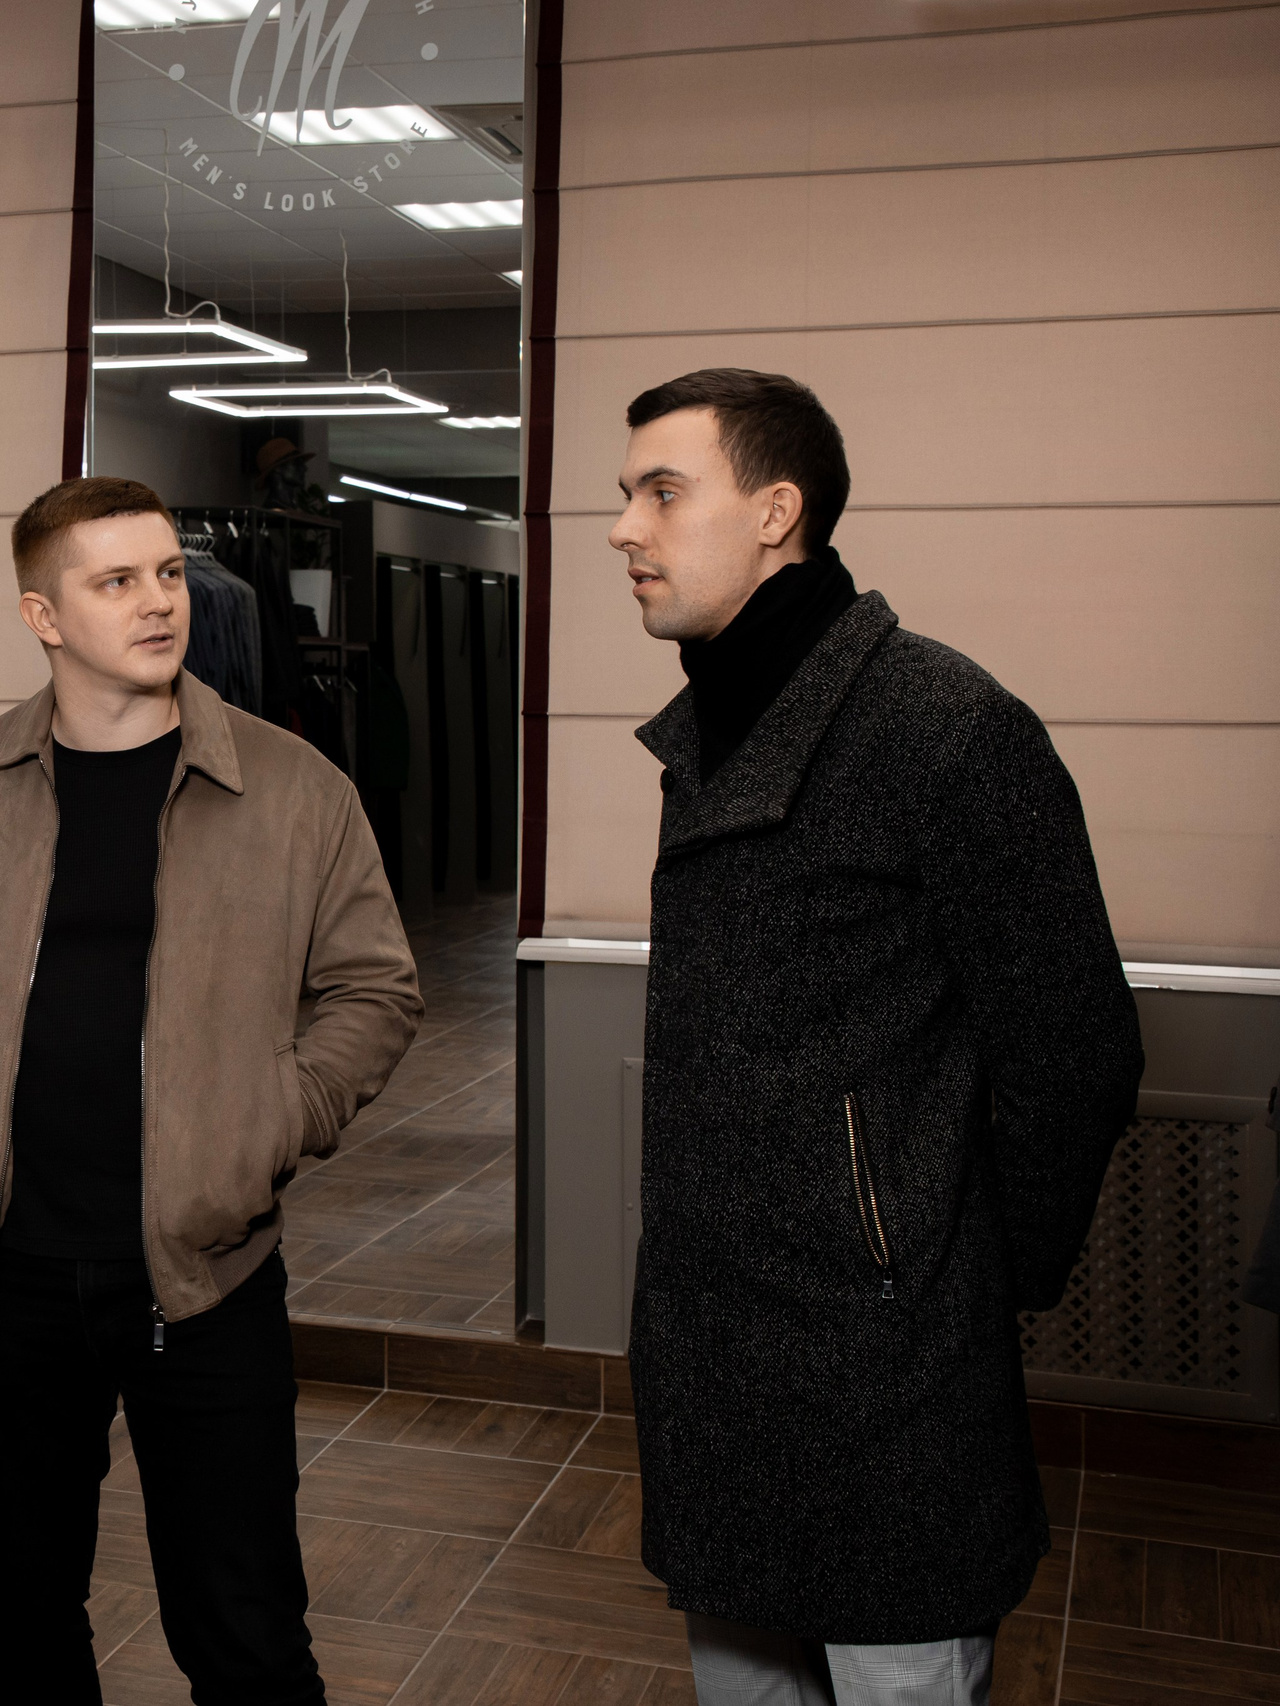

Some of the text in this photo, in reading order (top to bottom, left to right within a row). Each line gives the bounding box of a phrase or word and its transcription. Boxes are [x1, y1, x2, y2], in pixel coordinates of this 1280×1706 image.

[179, 121, 428, 212] MEN'S LOOK STORE
